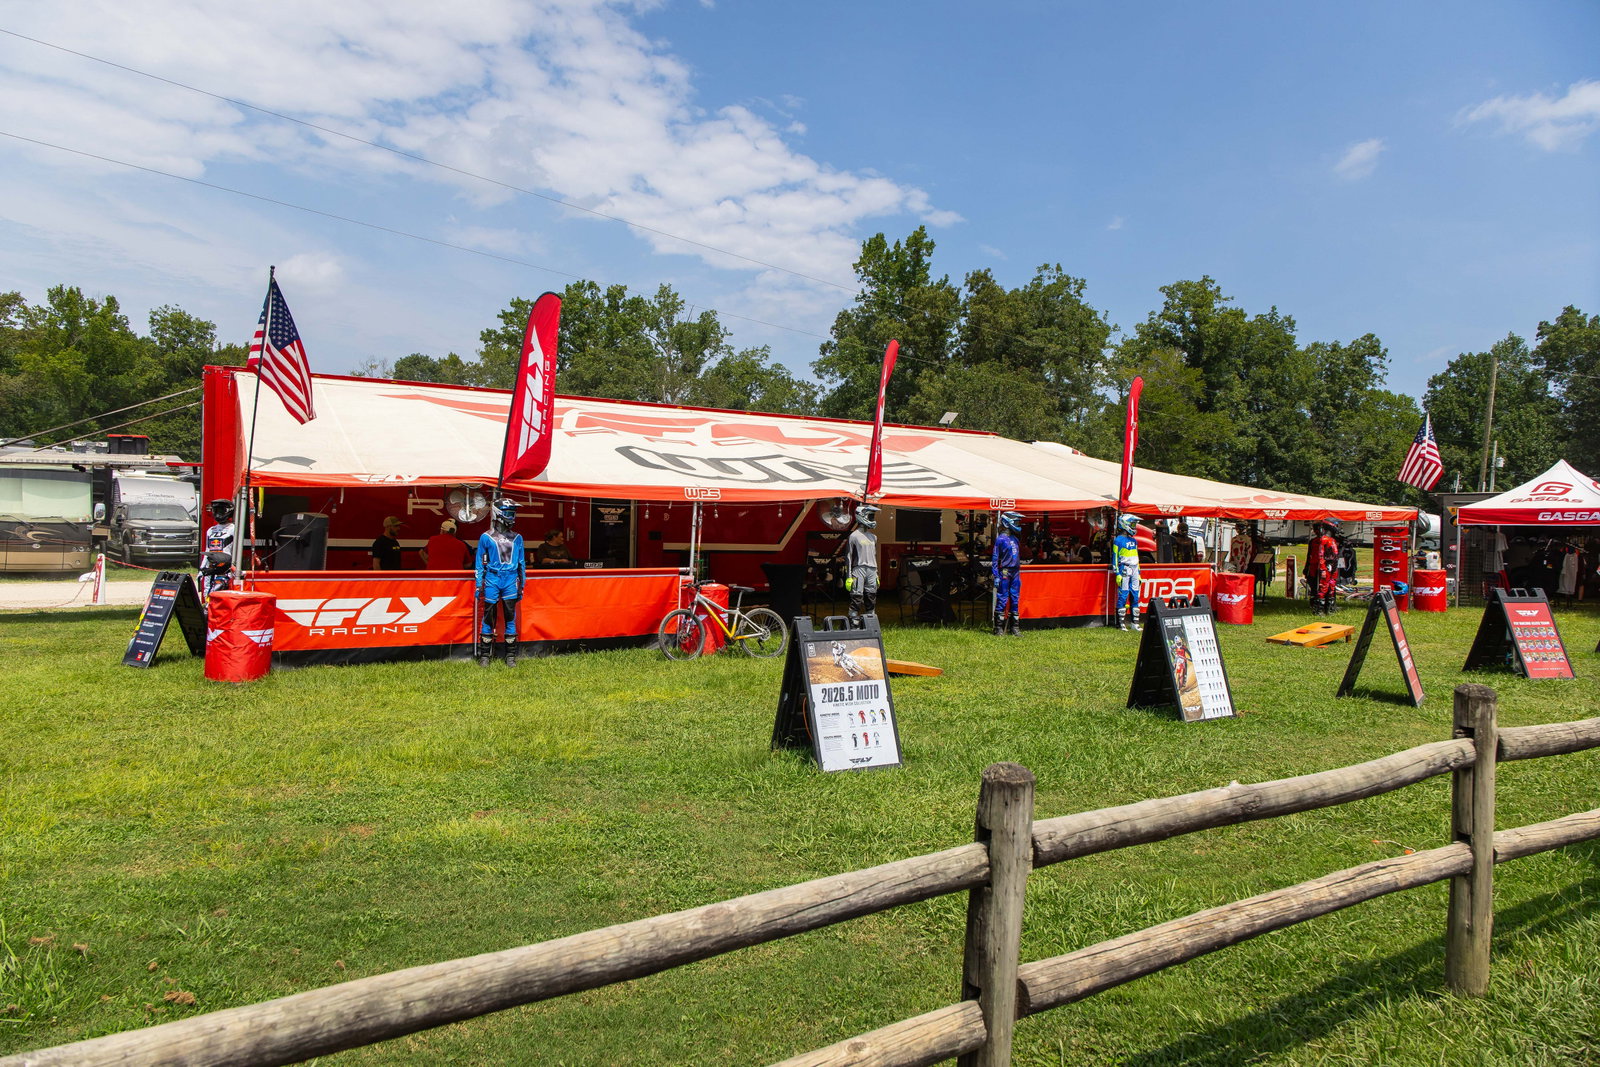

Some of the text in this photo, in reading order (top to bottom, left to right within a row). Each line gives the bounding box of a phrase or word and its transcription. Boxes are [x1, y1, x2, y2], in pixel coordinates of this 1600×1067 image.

[517, 325, 544, 460] FLY
[684, 487, 722, 500] WPS
[989, 497, 1017, 509] WPS
[1156, 504, 1185, 513] FLY
[1262, 509, 1290, 517] FLY
[1365, 511, 1383, 521] WPS
[1537, 511, 1600, 521] GASGA
[1412, 586, 1445, 595] FLY
[276, 596, 458, 627] FLY
[308, 625, 419, 637] RACING
[821, 684, 879, 704] 2026.5 MOTO
